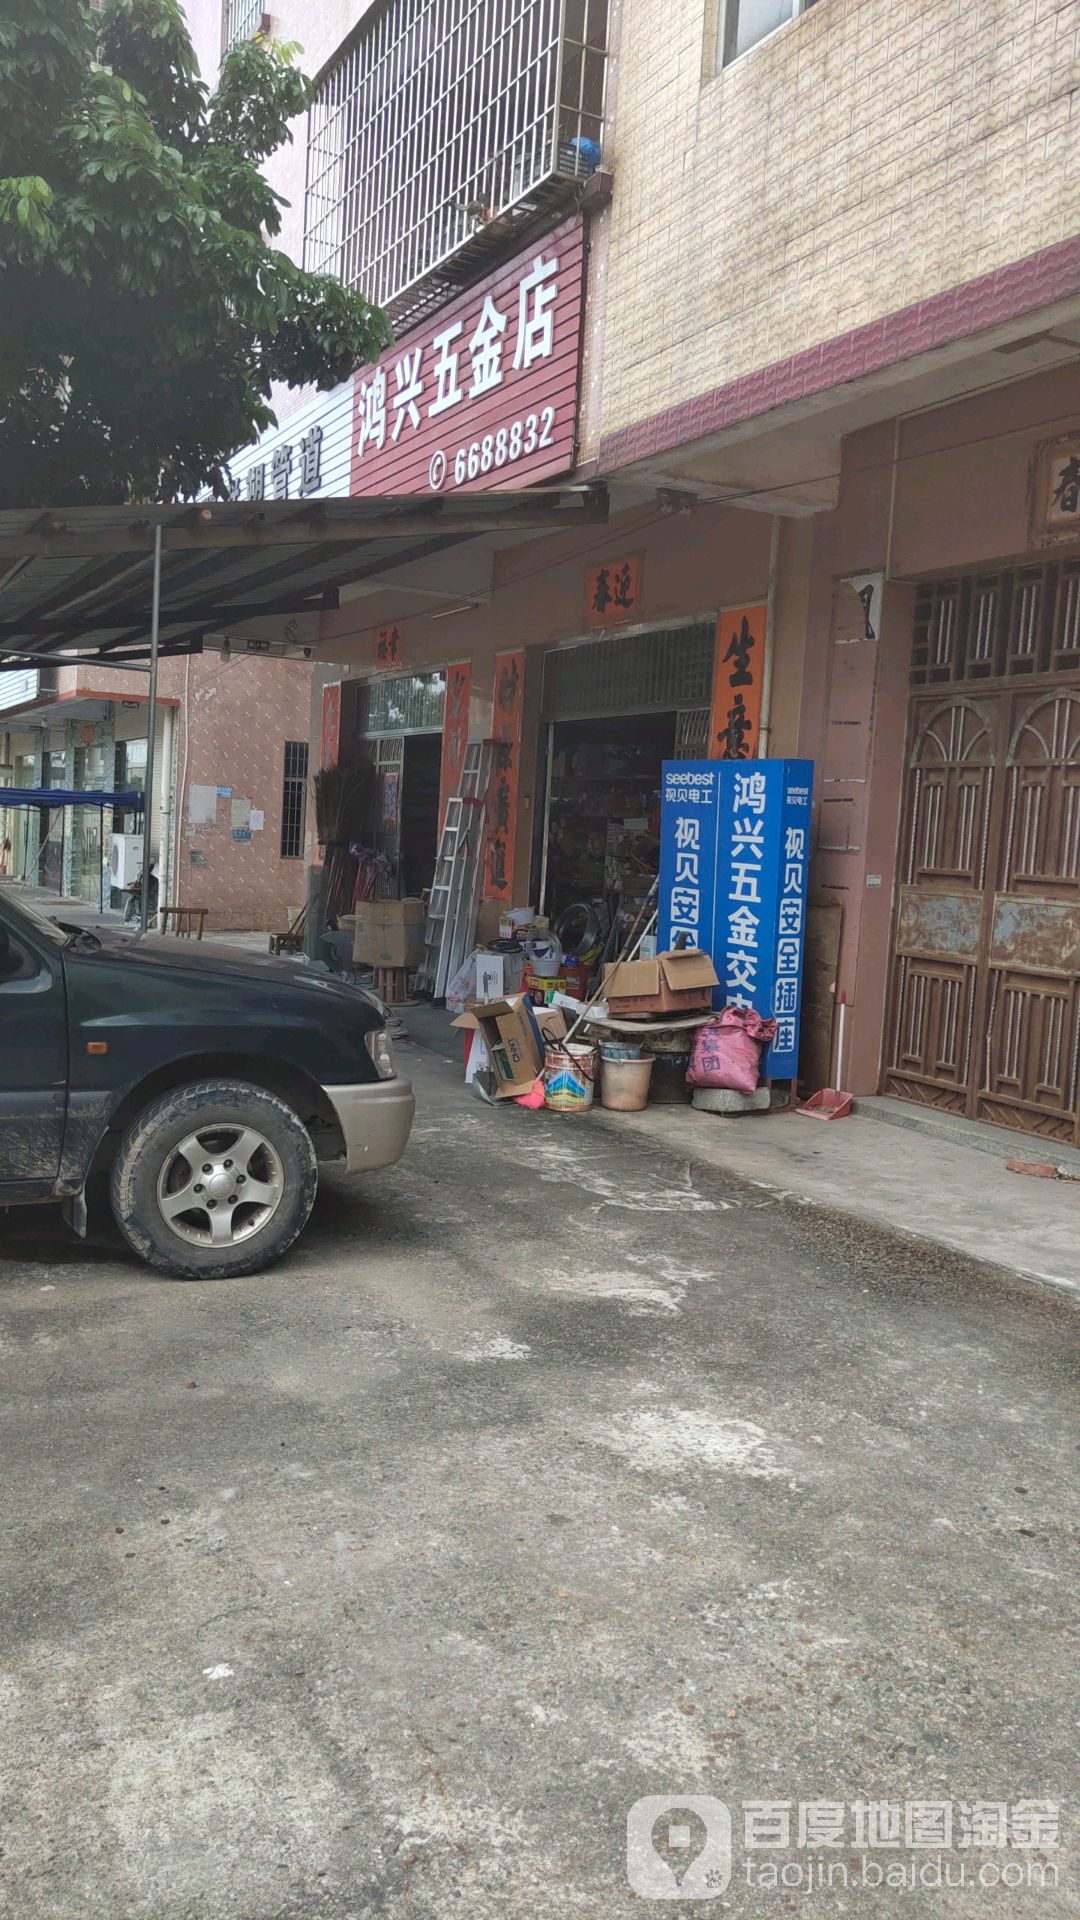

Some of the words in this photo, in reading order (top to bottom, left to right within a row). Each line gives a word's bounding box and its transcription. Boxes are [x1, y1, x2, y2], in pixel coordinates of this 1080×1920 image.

[358, 255, 559, 456] 鸿兴五金店
[454, 406, 556, 486] 6688832
[665, 772, 715, 786] seebest
[665, 788, 713, 804] 视贝电工
[787, 786, 809, 795] seebest
[772, 827, 806, 1054] 视贝安全插座
